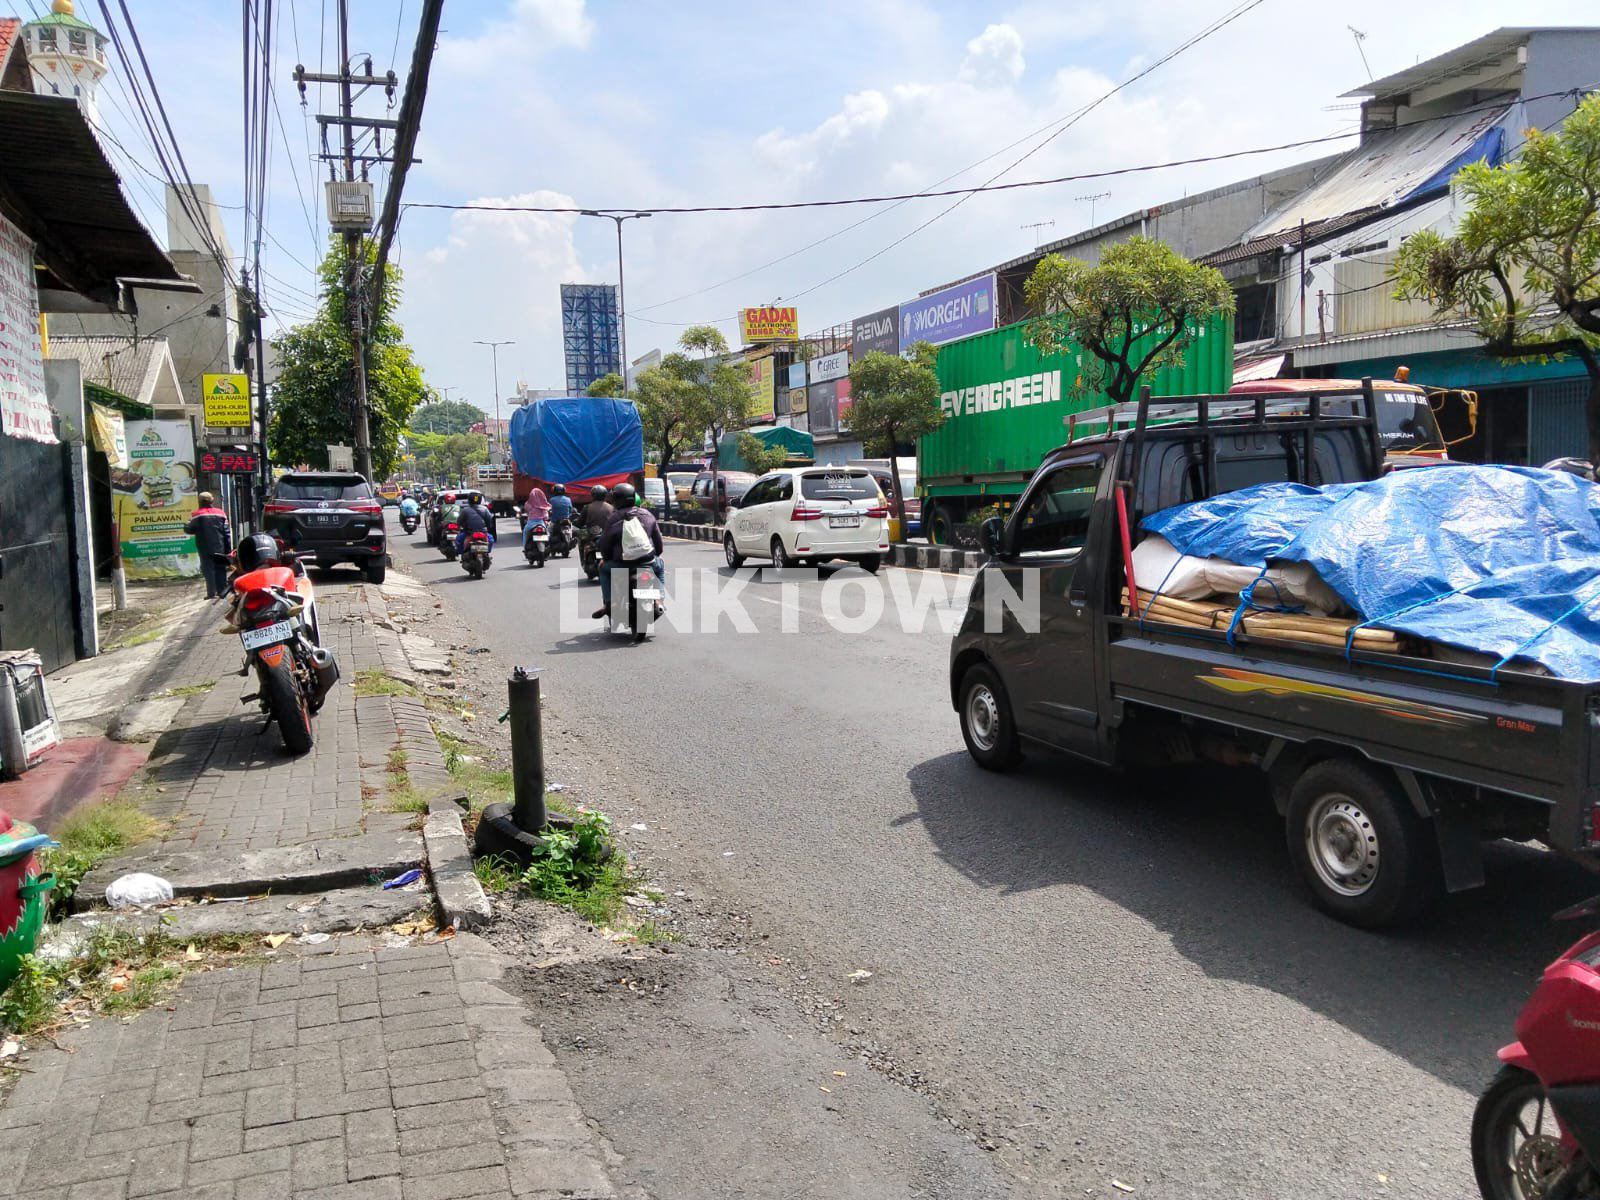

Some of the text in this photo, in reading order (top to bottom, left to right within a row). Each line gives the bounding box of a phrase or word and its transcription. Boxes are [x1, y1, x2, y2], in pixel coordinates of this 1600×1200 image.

[747, 308, 795, 322] GADAI
[913, 294, 970, 331] MORGEN
[823, 358, 840, 371] GREE
[941, 370, 1061, 417] EVERGREEN
[134, 514, 182, 523] PAHLAWAN
